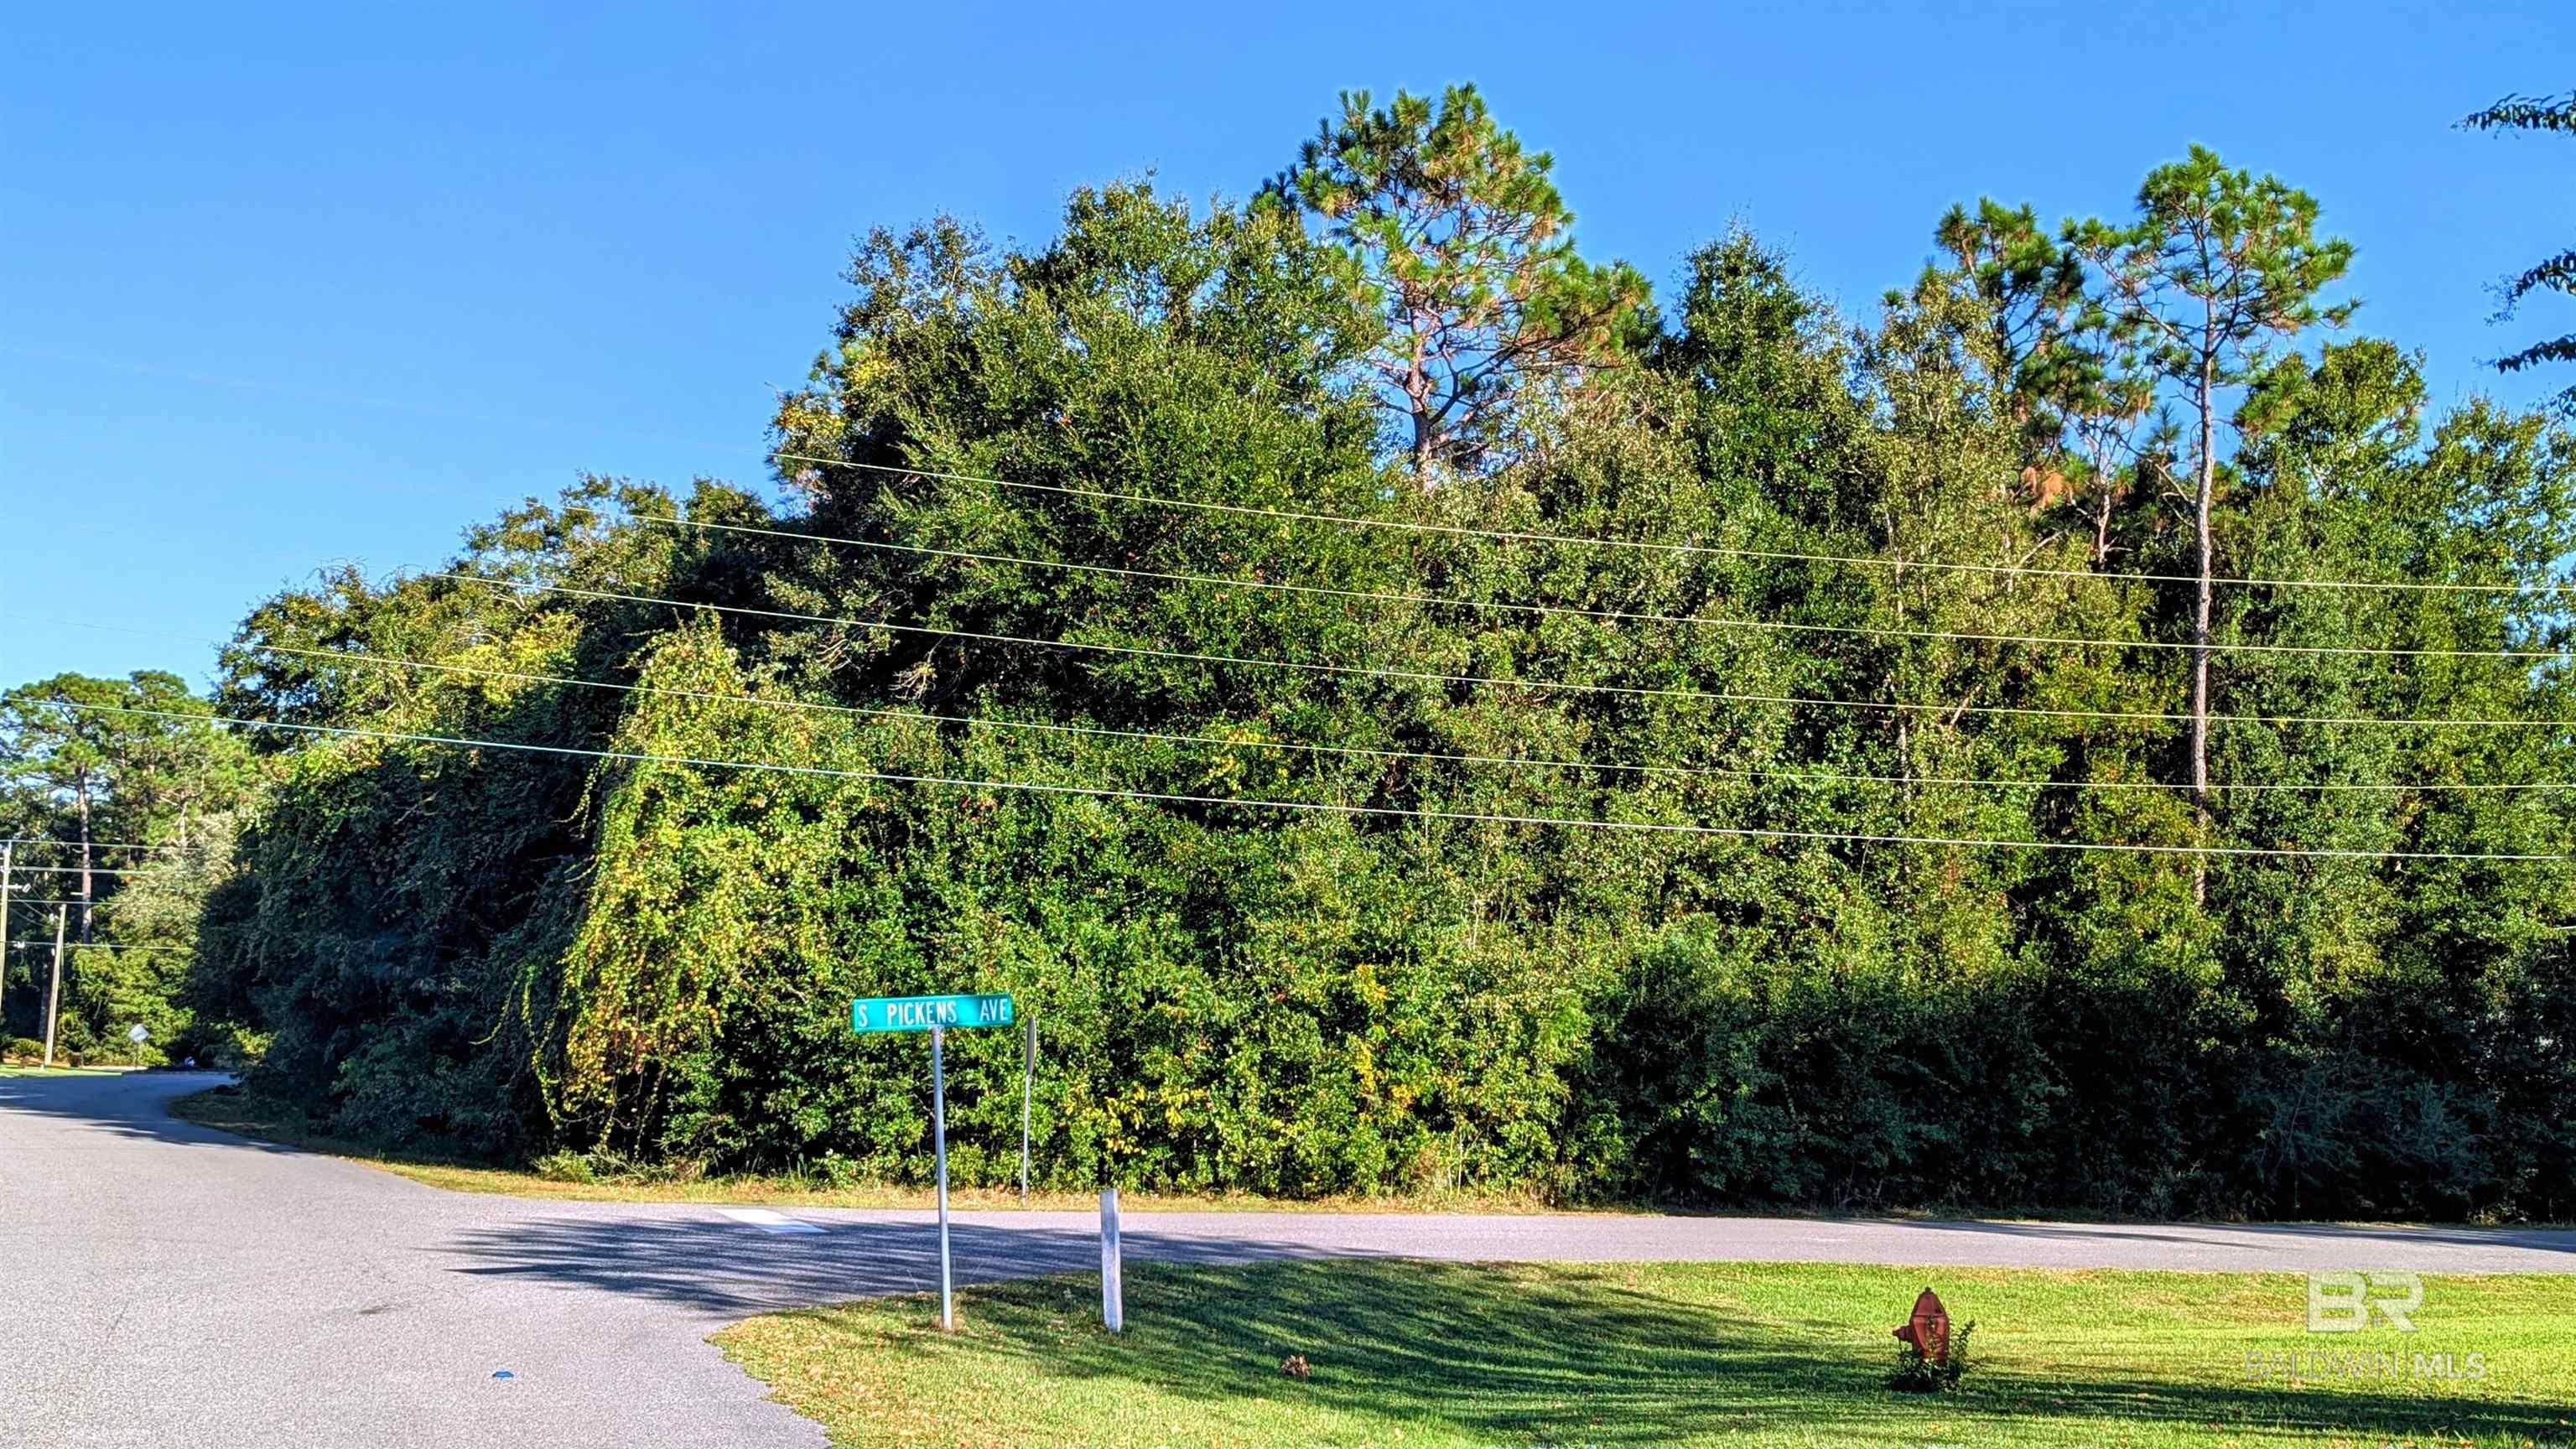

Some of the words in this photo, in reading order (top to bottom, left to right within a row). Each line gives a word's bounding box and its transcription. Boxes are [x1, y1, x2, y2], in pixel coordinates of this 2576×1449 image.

[858, 1004, 869, 1028] S
[887, 1001, 958, 1026] PICKENS
[979, 998, 1008, 1021] AVE
